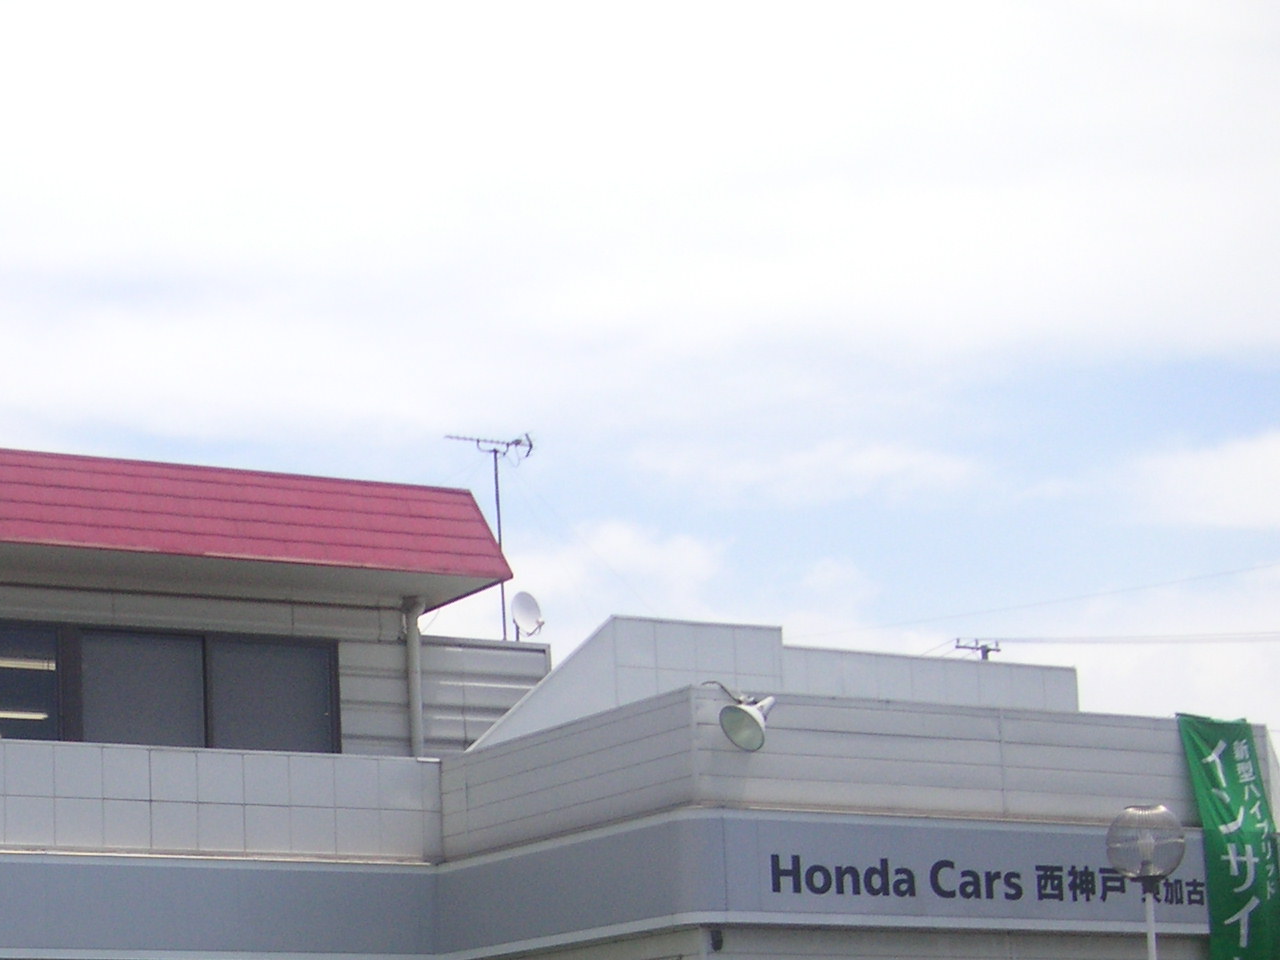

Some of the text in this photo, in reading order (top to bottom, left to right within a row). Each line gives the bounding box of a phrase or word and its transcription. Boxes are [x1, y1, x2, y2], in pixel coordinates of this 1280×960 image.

[770, 854, 916, 897] Honda
[929, 860, 1023, 901] Cars
[1035, 865, 1126, 901] 西神戸
